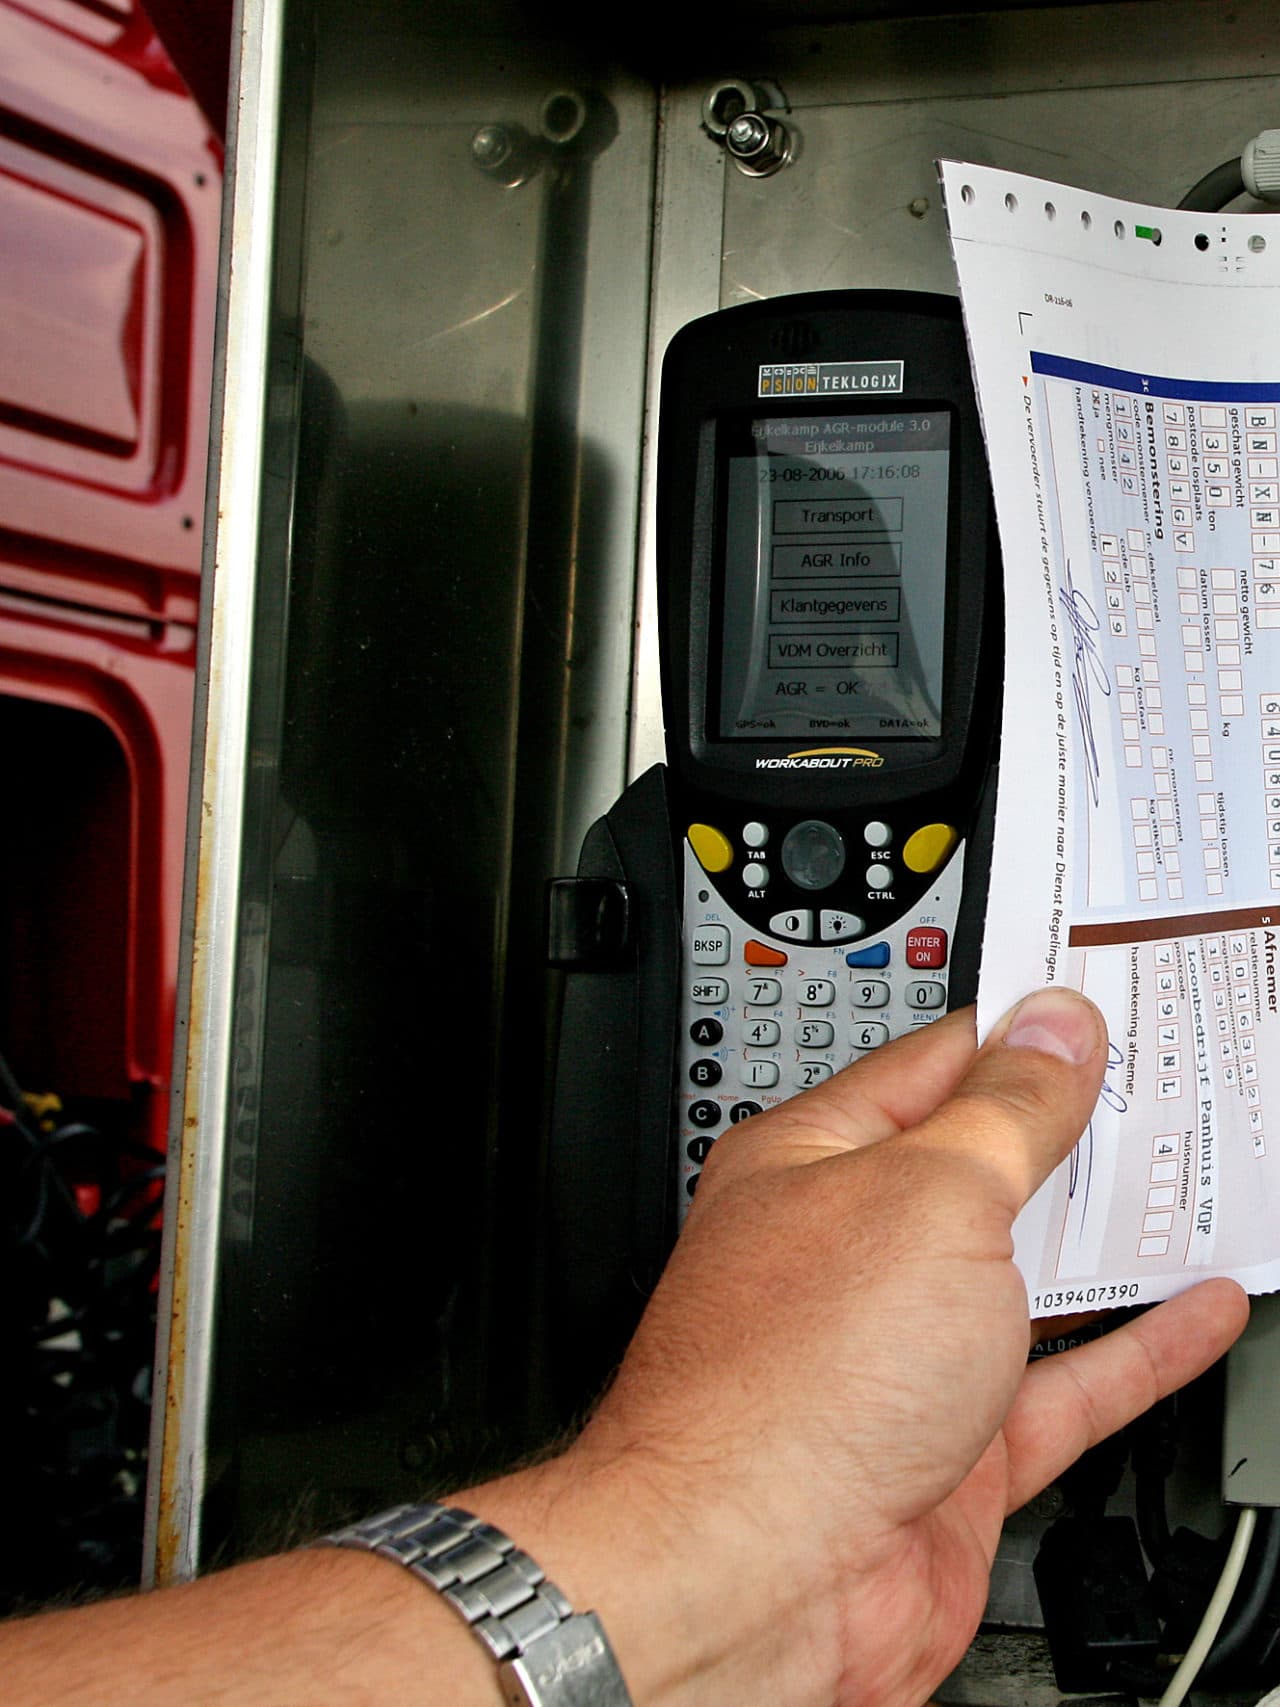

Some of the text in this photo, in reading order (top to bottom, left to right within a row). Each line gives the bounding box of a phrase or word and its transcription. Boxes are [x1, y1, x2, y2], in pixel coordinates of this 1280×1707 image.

[763, 375, 896, 392] PSION TEKLOGIX
[823, 421, 904, 433] AGR-module
[910, 420, 930, 431] 3.0
[1105, 393, 1119, 483] mengmonster
[1133, 399, 1150, 524] code monsternemer
[1187, 406, 1202, 521] postcode losplaats
[1229, 408, 1245, 508] geschat gewicht
[760, 465, 920, 482] 23-08-2006 17:16:08
[1075, 387, 1098, 552] handtekening vervoerder
[1144, 402, 1165, 540] Bemonstering
[803, 507, 873, 526] Transport
[1209, 511, 1217, 531] ton
[801, 552, 870, 568] AGR Info
[1120, 538, 1129, 569] code
[780, 598, 886, 615] Klantgegevens
[1199, 569, 1212, 652] datum lossen
[1240, 570, 1253, 655] netto gewicht
[778, 641, 887, 659] VDM Overzicht
[776, 681, 858, 695] AGR OK
[1023, 396, 1067, 984] De vervoerder stuurt de gegevens op tijd en op de juiste manier naar Dienst Regelingen.
[1136, 687, 1147, 731] fosfaat
[1222, 722, 1231, 737] kg
[756, 758, 883, 768] WORKABOUT PRO
[1217, 792, 1230, 877] tijdstip lossen
[868, 892, 894, 900] CTRL
[695, 940, 722, 951] BKSP
[908, 937, 939, 947] ENTER
[916, 952, 930, 961] ON
[1174, 942, 1186, 1000] postcode
[1249, 932, 1262, 1023] relatienummer
[1263, 931, 1278, 1013] Afnemer
[693, 986, 720, 996] SHIFT
[699, 1026, 709, 1038] A
[1125, 947, 1140, 1096] handtekening afnemer
[698, 1067, 708, 1080] B
[1187, 951, 1214, 1235] Loonbedrijf Panhuis VOF
[696, 1107, 707, 1120] C
[1179, 1131, 1193, 1211] huisnummer
[1035, 1284, 1139, 1309] 1039407390
